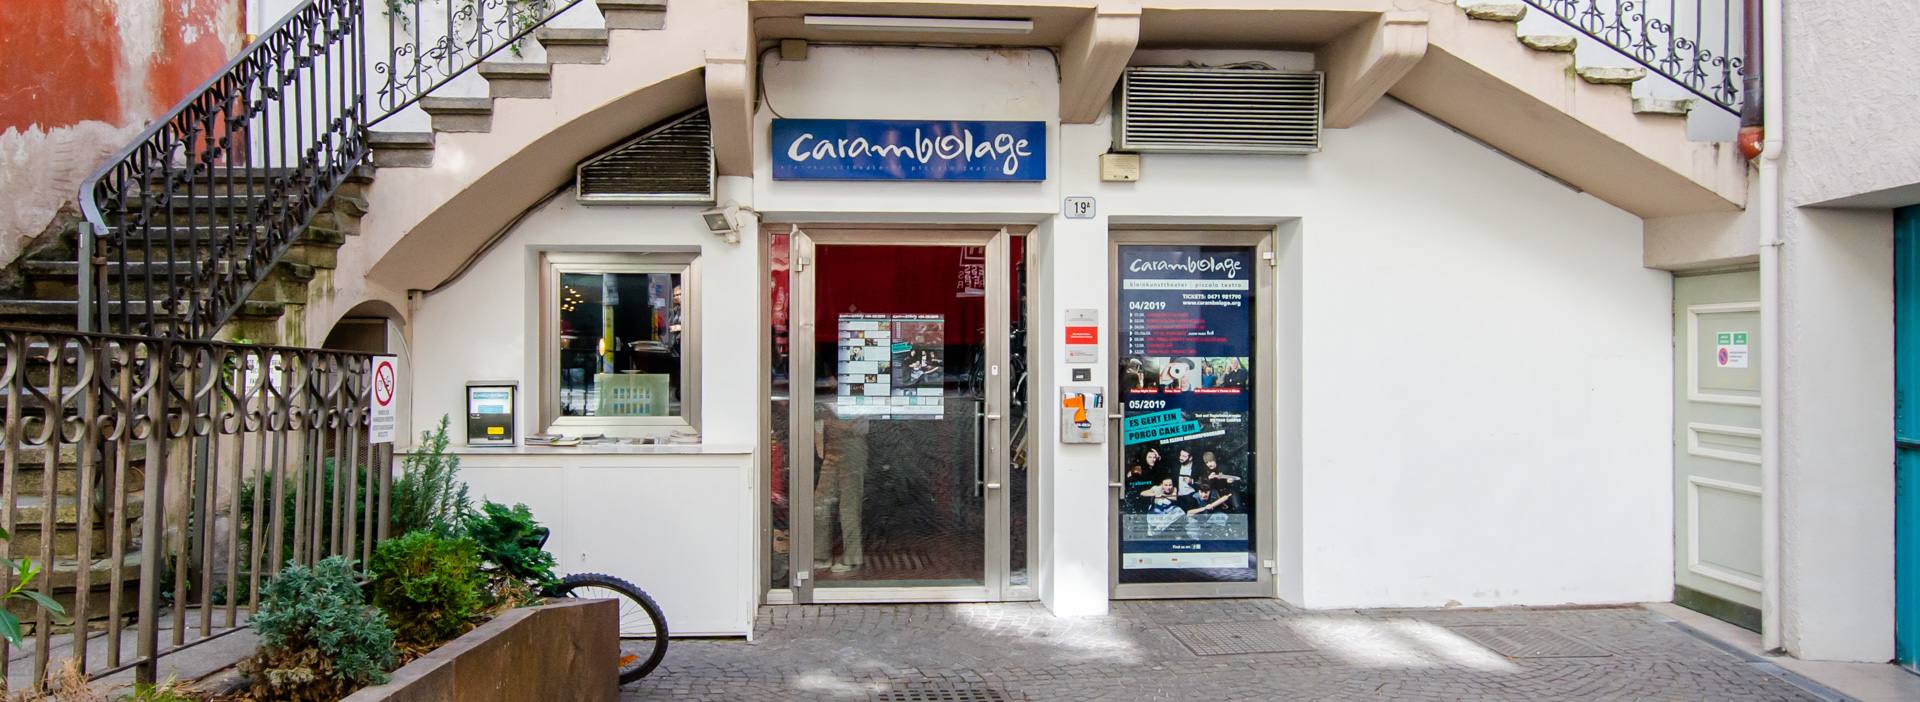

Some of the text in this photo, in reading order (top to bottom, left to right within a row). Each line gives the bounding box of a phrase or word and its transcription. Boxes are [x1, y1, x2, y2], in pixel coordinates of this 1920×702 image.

[1129, 301, 1166, 310] 04/2019
[1129, 400, 1166, 409] 05/2019
[1129, 413, 1177, 427] ES GEHT EIN
[1129, 429, 1157, 441] PORCO
[1159, 425, 1180, 436] CANE
[1182, 423, 1195, 432] UM
